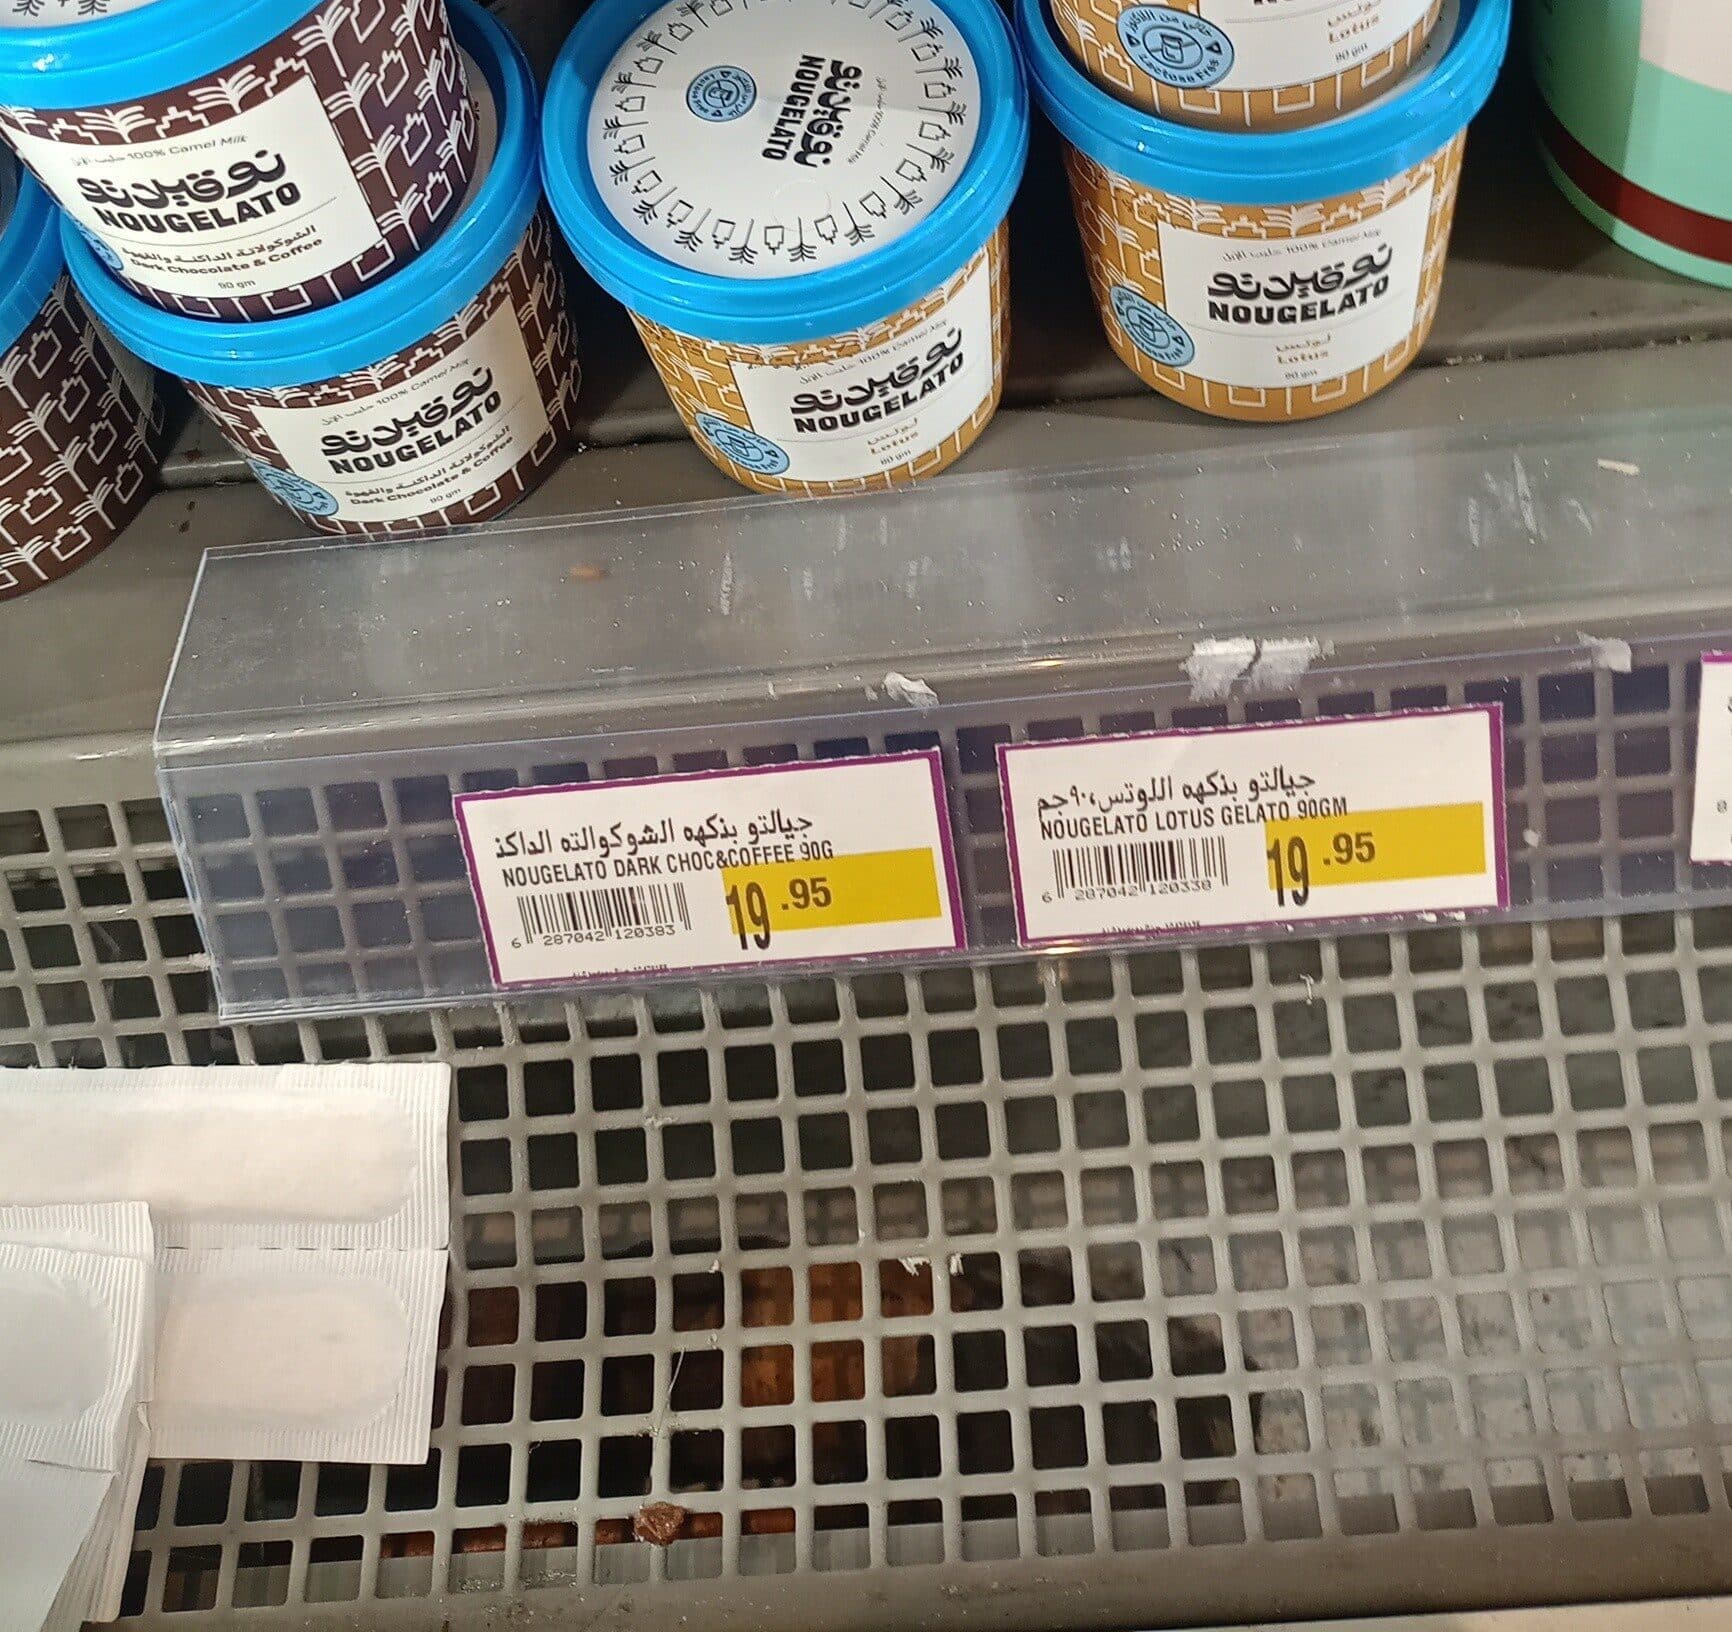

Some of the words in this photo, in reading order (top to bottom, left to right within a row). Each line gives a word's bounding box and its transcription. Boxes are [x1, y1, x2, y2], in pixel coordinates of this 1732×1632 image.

[1328, 14, 1381, 44] Lotus
[761, 54, 828, 162] NOUGELATO
[128, 146, 166, 161] 100%
[169, 138, 218, 156] Camel
[220, 134, 249, 148] Milk
[76, 149, 287, 210] نوقيلاتو
[92, 181, 302, 234] NOUGELATO
[130, 258, 166, 274] Dark
[167, 261, 251, 275] Chocolate
[252, 257, 267, 269] &
[268, 237, 324, 265] Coffee
[1207, 243, 1394, 302] نوقيلاتو
[1207, 274, 1390, 326] NOUGELATO
[789, 326, 963, 416] نوقيلاتو
[1275, 349, 1330, 366] Lotus
[320, 365, 494, 458] نوقيلاتو
[793, 351, 965, 434] NOUGELATO
[327, 390, 501, 476] NOUGELATO
[349, 495, 385, 506] Dark
[385, 473, 460, 503] Chocolate
[472, 435, 515, 469] Coffee
[1039, 813, 1149, 841] NOUGELATO
[1155, 807, 1216, 832] LOTUS
[1221, 799, 1291, 826] GELATO
[1296, 795, 1350, 820] 90GM
[501, 859, 607, 889] NOUGELATO
[613, 853, 663, 878] DARK
[665, 843, 796, 873] CHOC&COFFEE
[799, 839, 835, 862] 90G
[1041, 891, 1052, 904] 6
[511, 937, 522, 950] 6
[542, 930, 606, 948] 287042
[614, 923, 677, 941] 120383
